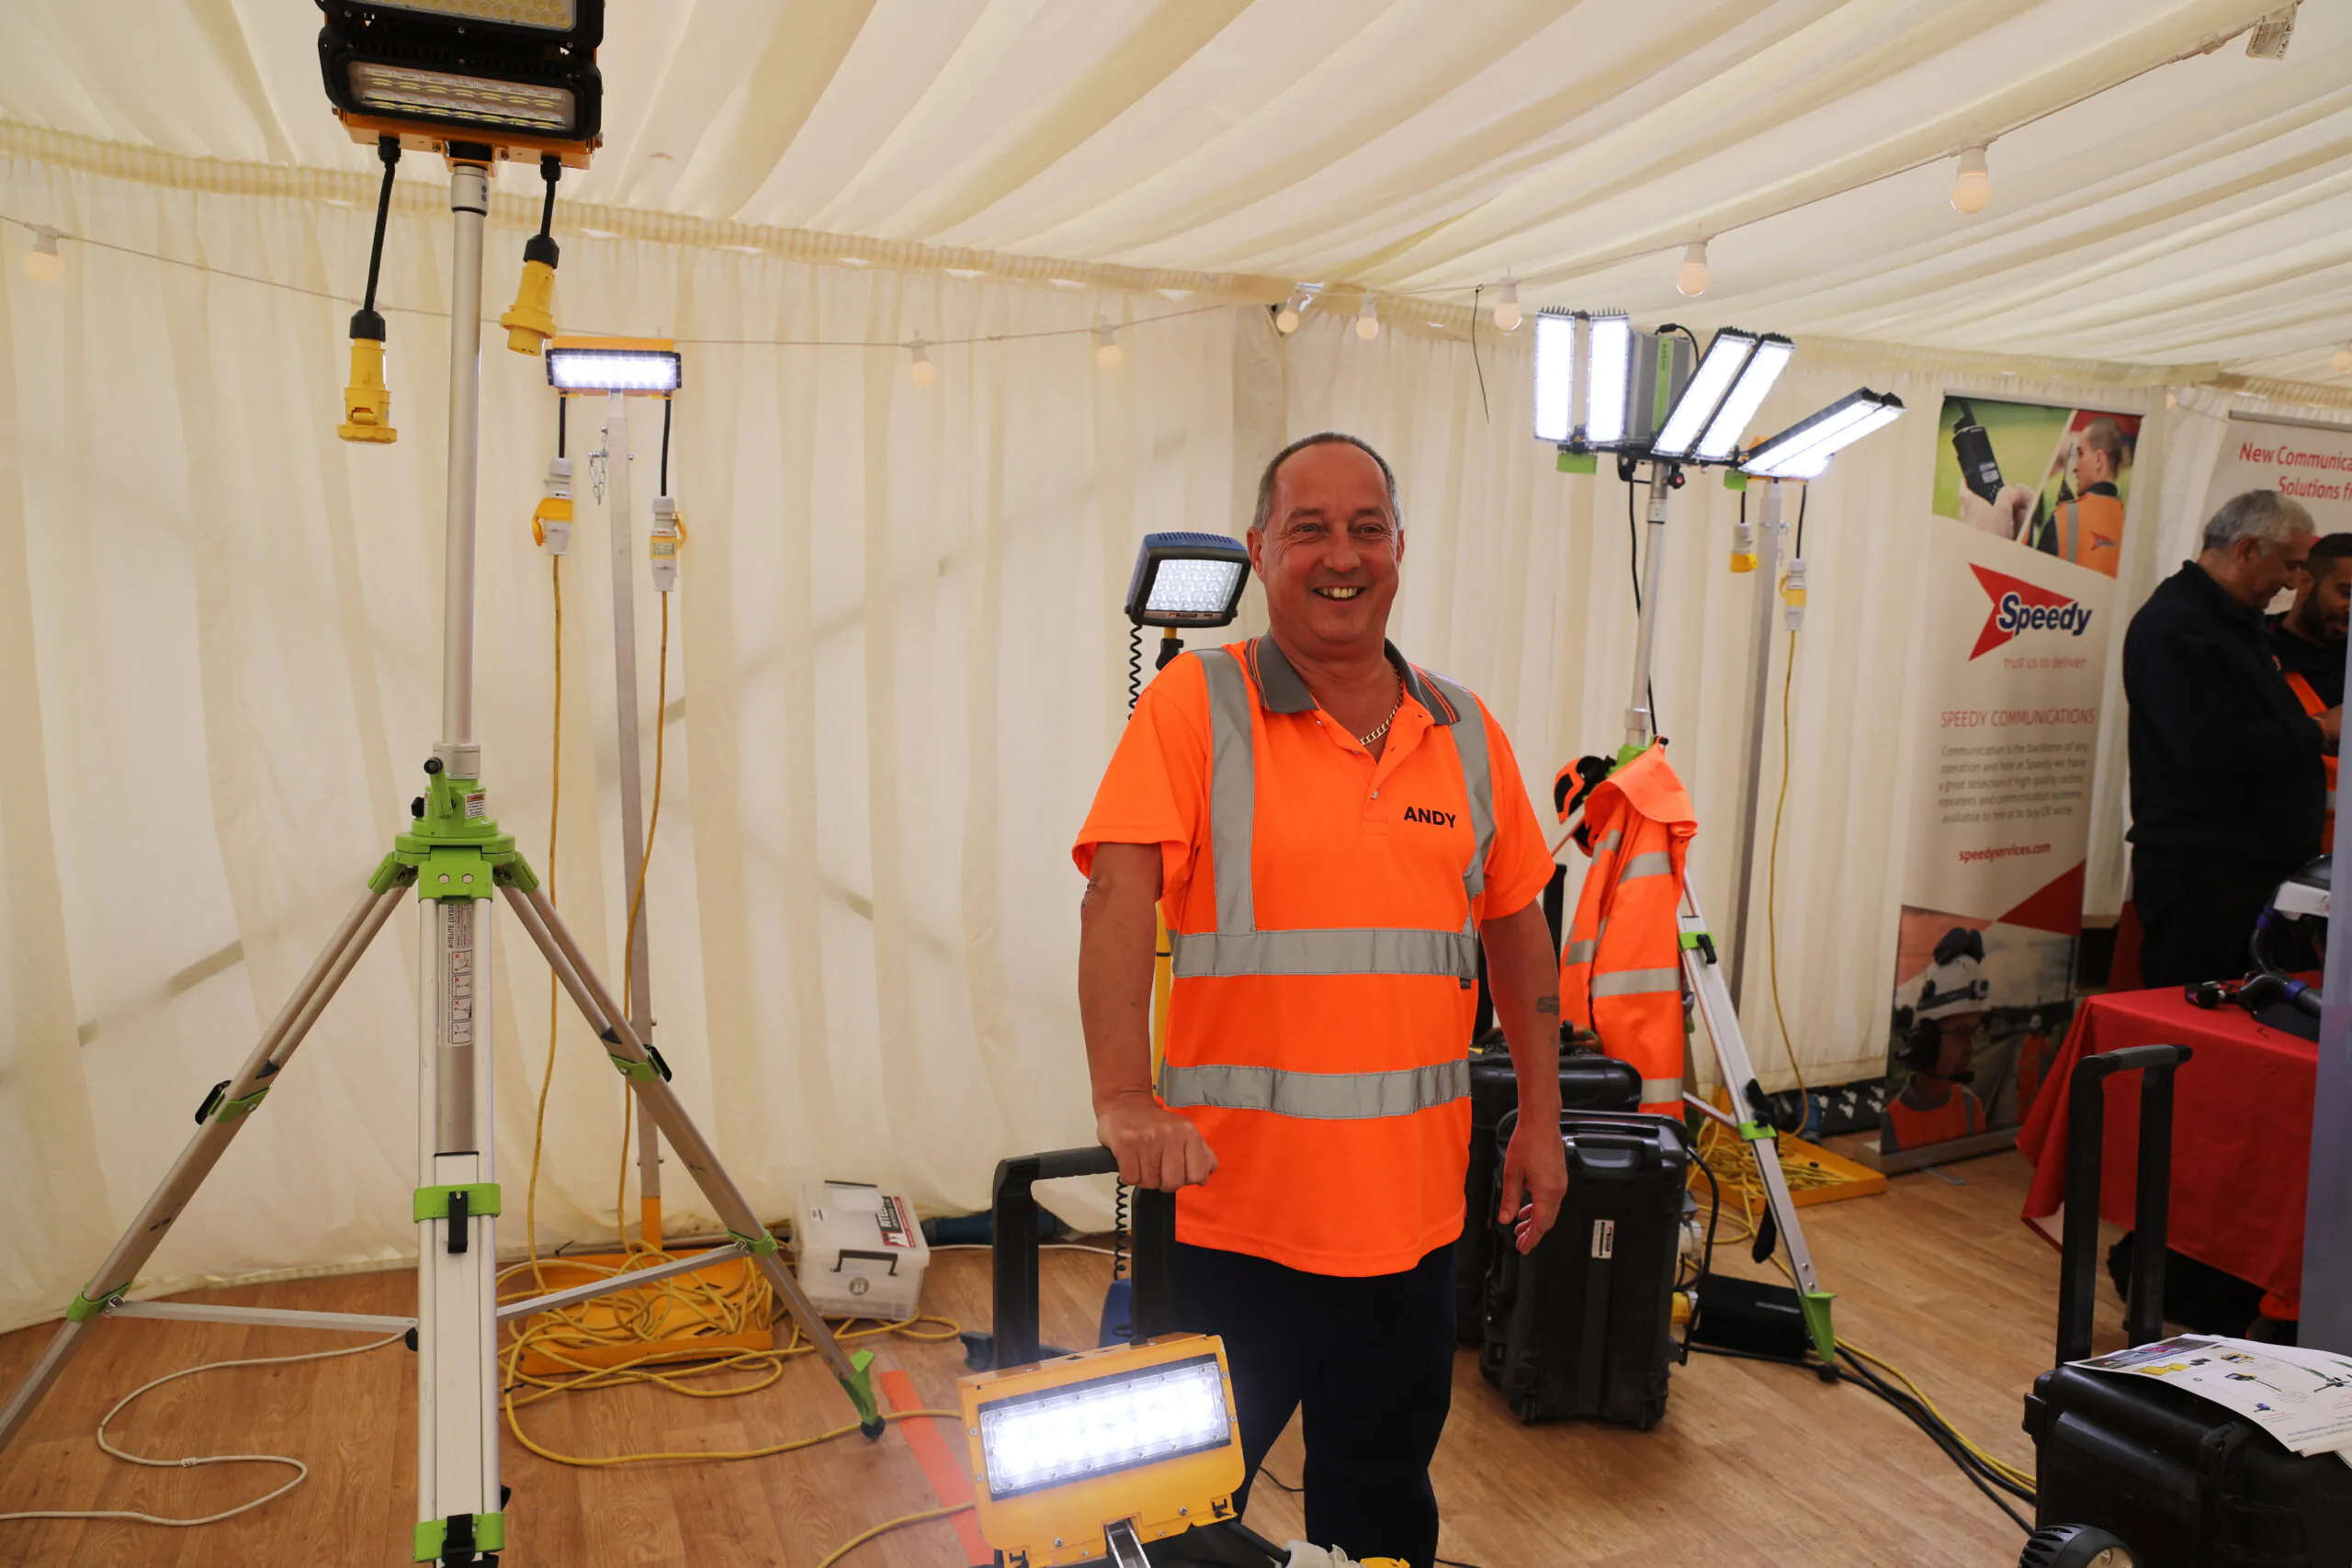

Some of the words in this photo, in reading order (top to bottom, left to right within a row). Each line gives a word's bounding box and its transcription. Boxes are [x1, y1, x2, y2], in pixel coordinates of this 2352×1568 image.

[2239, 441, 2275, 463] New
[2278, 476, 2341, 500] Solutions
[1997, 592, 2093, 637] Speedy
[2004, 657, 2024, 670] trust
[2026, 658, 2038, 670] us
[2040, 657, 2050, 669] to
[2051, 655, 2086, 669] deliver
[1940, 710, 1988, 728] SPEEDY
[1990, 708, 2096, 727] COMMUNICATIONS
[1942, 745, 2006, 757] Communication
[1940, 762, 1981, 775] operation
[1983, 761, 1998, 773] and
[1944, 780, 1966, 794] great
[1979, 792, 1995, 806] and
[1404, 807, 1456, 829] ANDY
[1942, 808, 1981, 824] available
[1983, 810, 1992, 822] to
[2027, 806, 2041, 820] buy
[1958, 842, 2052, 863] speedyservices.com
[853, 1282, 865, 1294] A4
